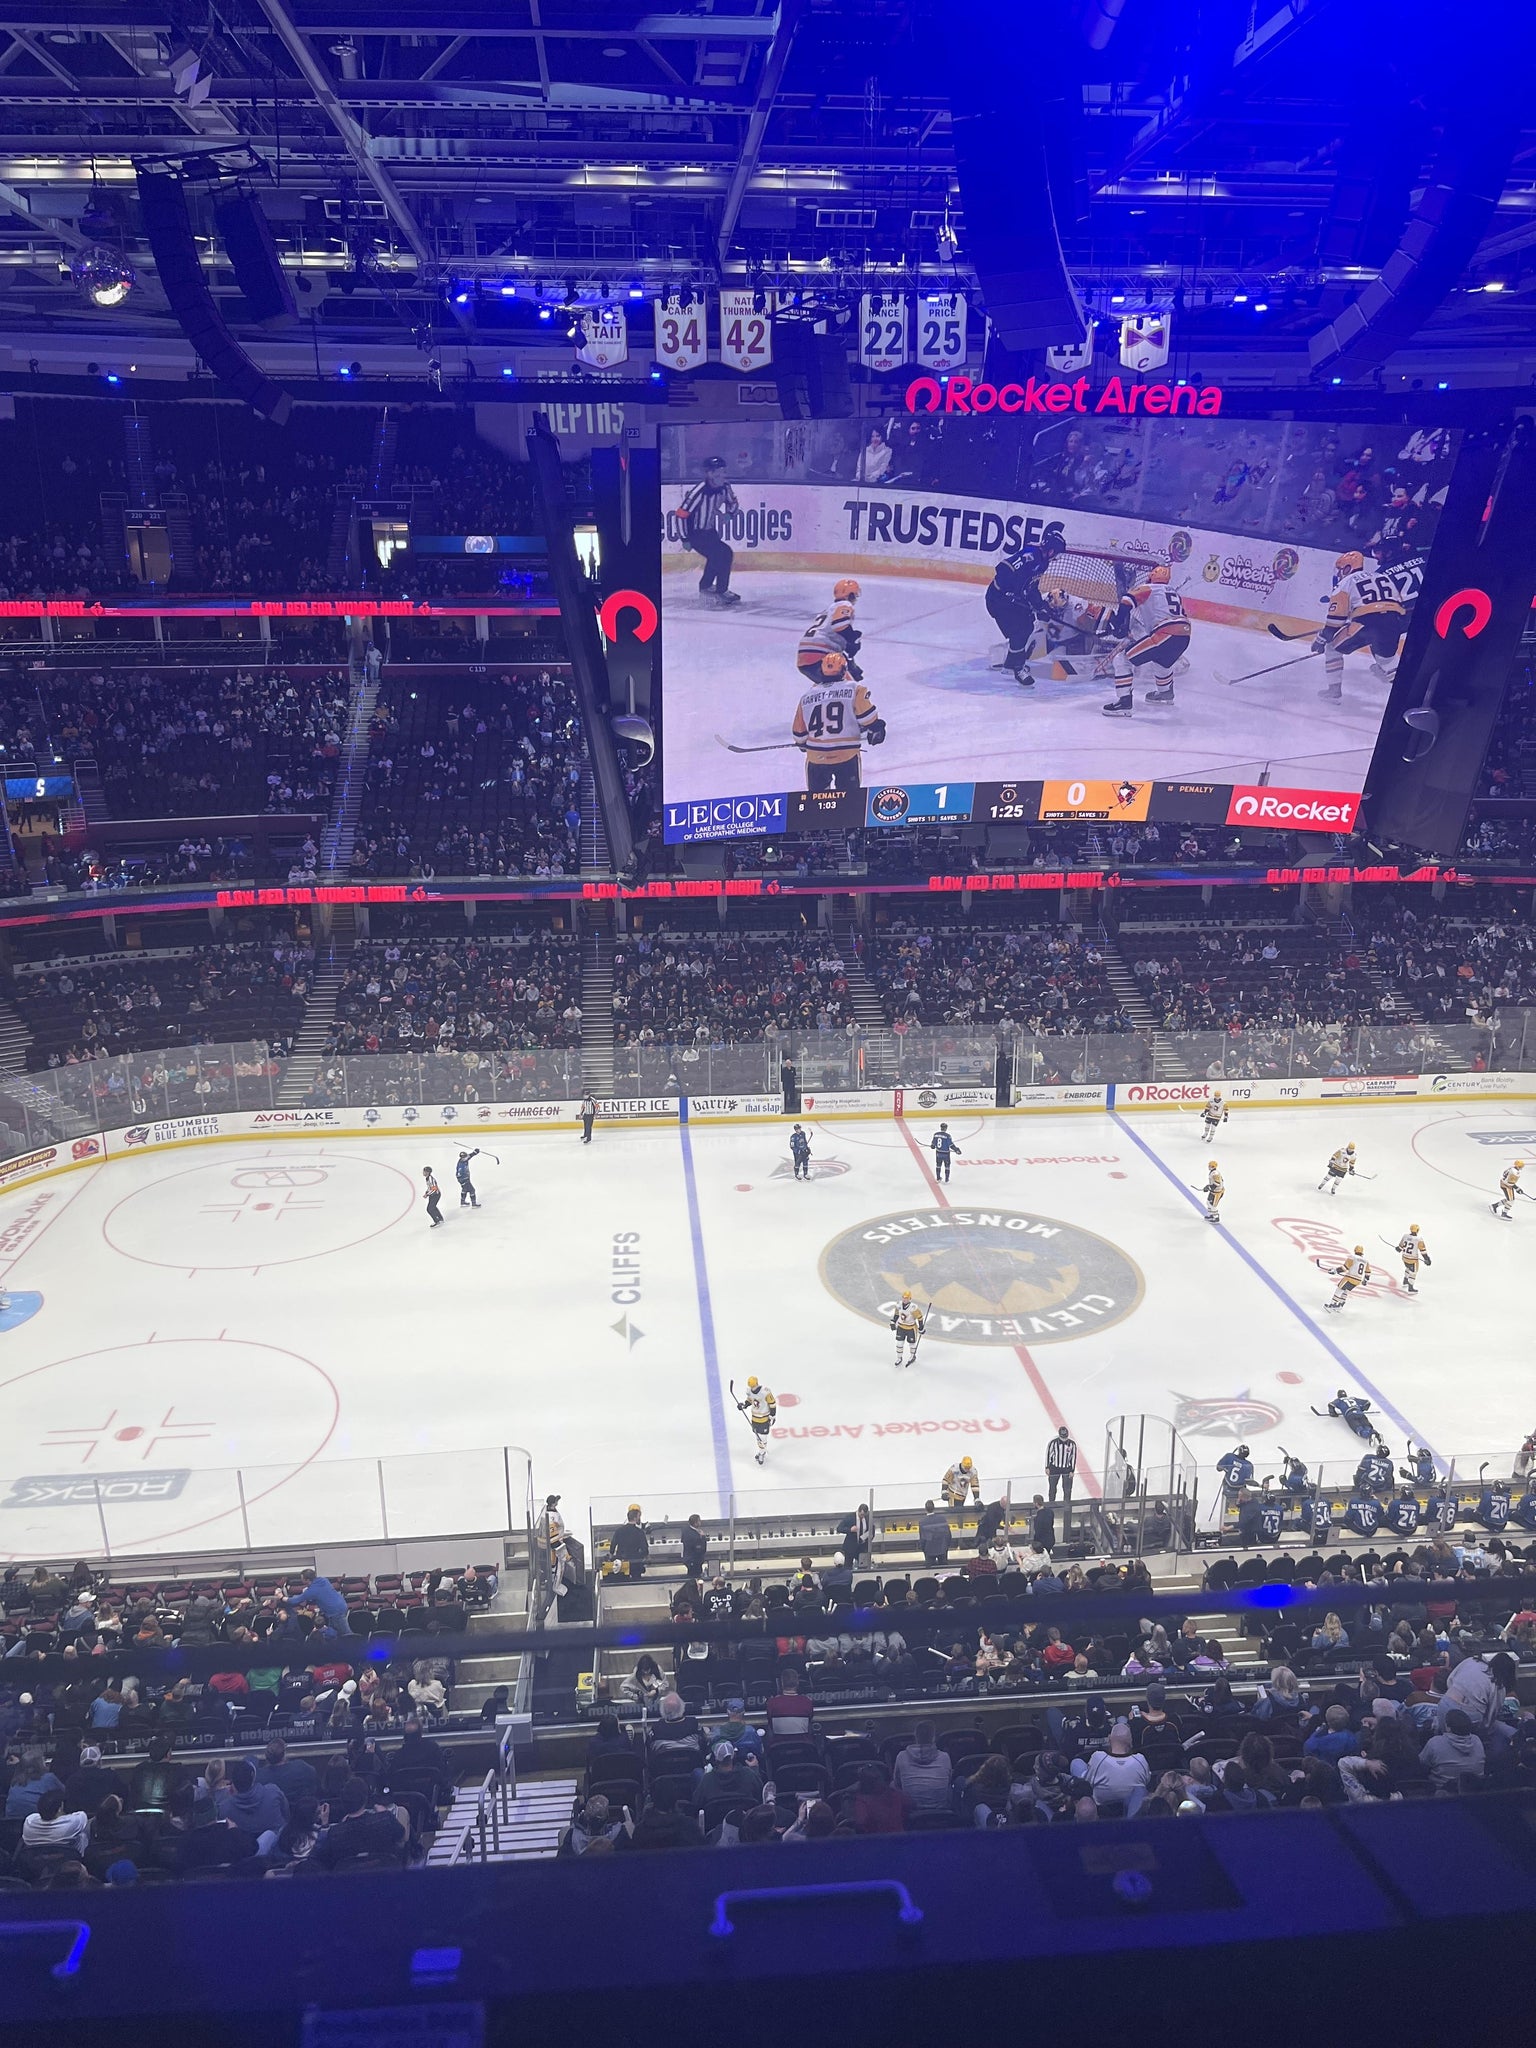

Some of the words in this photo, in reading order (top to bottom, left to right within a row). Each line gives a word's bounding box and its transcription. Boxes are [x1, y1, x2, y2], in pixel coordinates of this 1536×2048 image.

[668, 307, 693, 316] CARR
[868, 308, 900, 317] NANCE
[928, 308, 956, 317] PRICE
[592, 326, 623, 339] TAIT
[662, 319, 701, 354] 34
[726, 319, 765, 354] 42
[864, 320, 903, 355] 22
[923, 320, 961, 355] 25
[945, 376, 1091, 413] Rocket
[1094, 376, 1223, 415] Arena
[46, 601, 85, 617] NIGHT
[251, 601, 283, 616] GLOW
[286, 601, 308, 616] RED
[310, 601, 333, 616] FOR
[335, 601, 378, 616] WOMEN
[380, 601, 415, 616] NIGHT
[1164, 592, 1186, 616] 5
[808, 701, 845, 738] 49
[812, 791, 847, 800] PENALTY
[934, 785, 948, 809] 1
[1067, 782, 1086, 806] 0
[1179, 785, 1215, 793] PENALTY
[818, 801, 837, 810] 1:03
[990, 804, 1024, 818] 1:25
[1259, 796, 1352, 823] Rocket
[683, 833, 693, 841] OF
[693, 829, 736, 840] OSTEOPATHIC
[736, 826, 768, 836] MEDICINE
[695, 825, 712, 833] LAKE
[726, 821, 755, 830] COLLEGE
[928, 876, 963, 891] GLOW
[966, 875, 990, 890] RED
[992, 874, 1015, 889] FOR
[1018, 873, 1065, 888] WOMEN
[1067, 872, 1105, 888] NIGHT
[1266, 868, 1300, 883] GLOW
[1302, 868, 1326, 883] RED
[1328, 867, 1351, 882] FOR
[1353, 866, 1399, 882] WOMEN
[314, 886, 365, 903] WOMEN
[368, 886, 407, 902] NIGHT
[582, 883, 618, 899] GLOW
[648, 881, 672, 897] FOR
[675, 880, 722, 897] WOMEN
[725, 879, 763, 896] NIGHT
[1063, 1091, 1103, 1099] ENBRIDGE
[1146, 1083, 1210, 1101] Rocket
[1232, 1088, 1251, 1099] nrg
[1279, 1087, 1299, 1098] nrg
[508, 1107, 545, 1117] CHARGE
[545, 1106, 560, 1116] ON
[650, 1099, 670, 1111] ICE
[745, 1103, 761, 1113] that
[762, 1102, 781, 1114] slap
[153, 1116, 219, 1131] COLUMBUS
[253, 1111, 334, 1123] AVONLAKE
[154, 1129, 177, 1142] BLUE
[181, 1124, 220, 1139] JACKETS
[936, 1137, 943, 1149] 8
[955, 1157, 1019, 1166] Arena
[1023, 1155, 1101, 1165] Rocket
[861, 1212, 1064, 1245] MONSTERS
[610, 1231, 642, 1305] CLIFFS
[1357, 1262, 1365, 1275] 8
[876, 1292, 1117, 1336] CLEVELAD
[771, 1423, 864, 1440] Arena
[872, 1418, 982, 1437] Rocket
[1229, 1467, 1240, 1483] 6
[1490, 1501, 1508, 1519] 20
[1262, 1515, 1280, 1534] 43
[1397, 1510, 1417, 1527] 24
